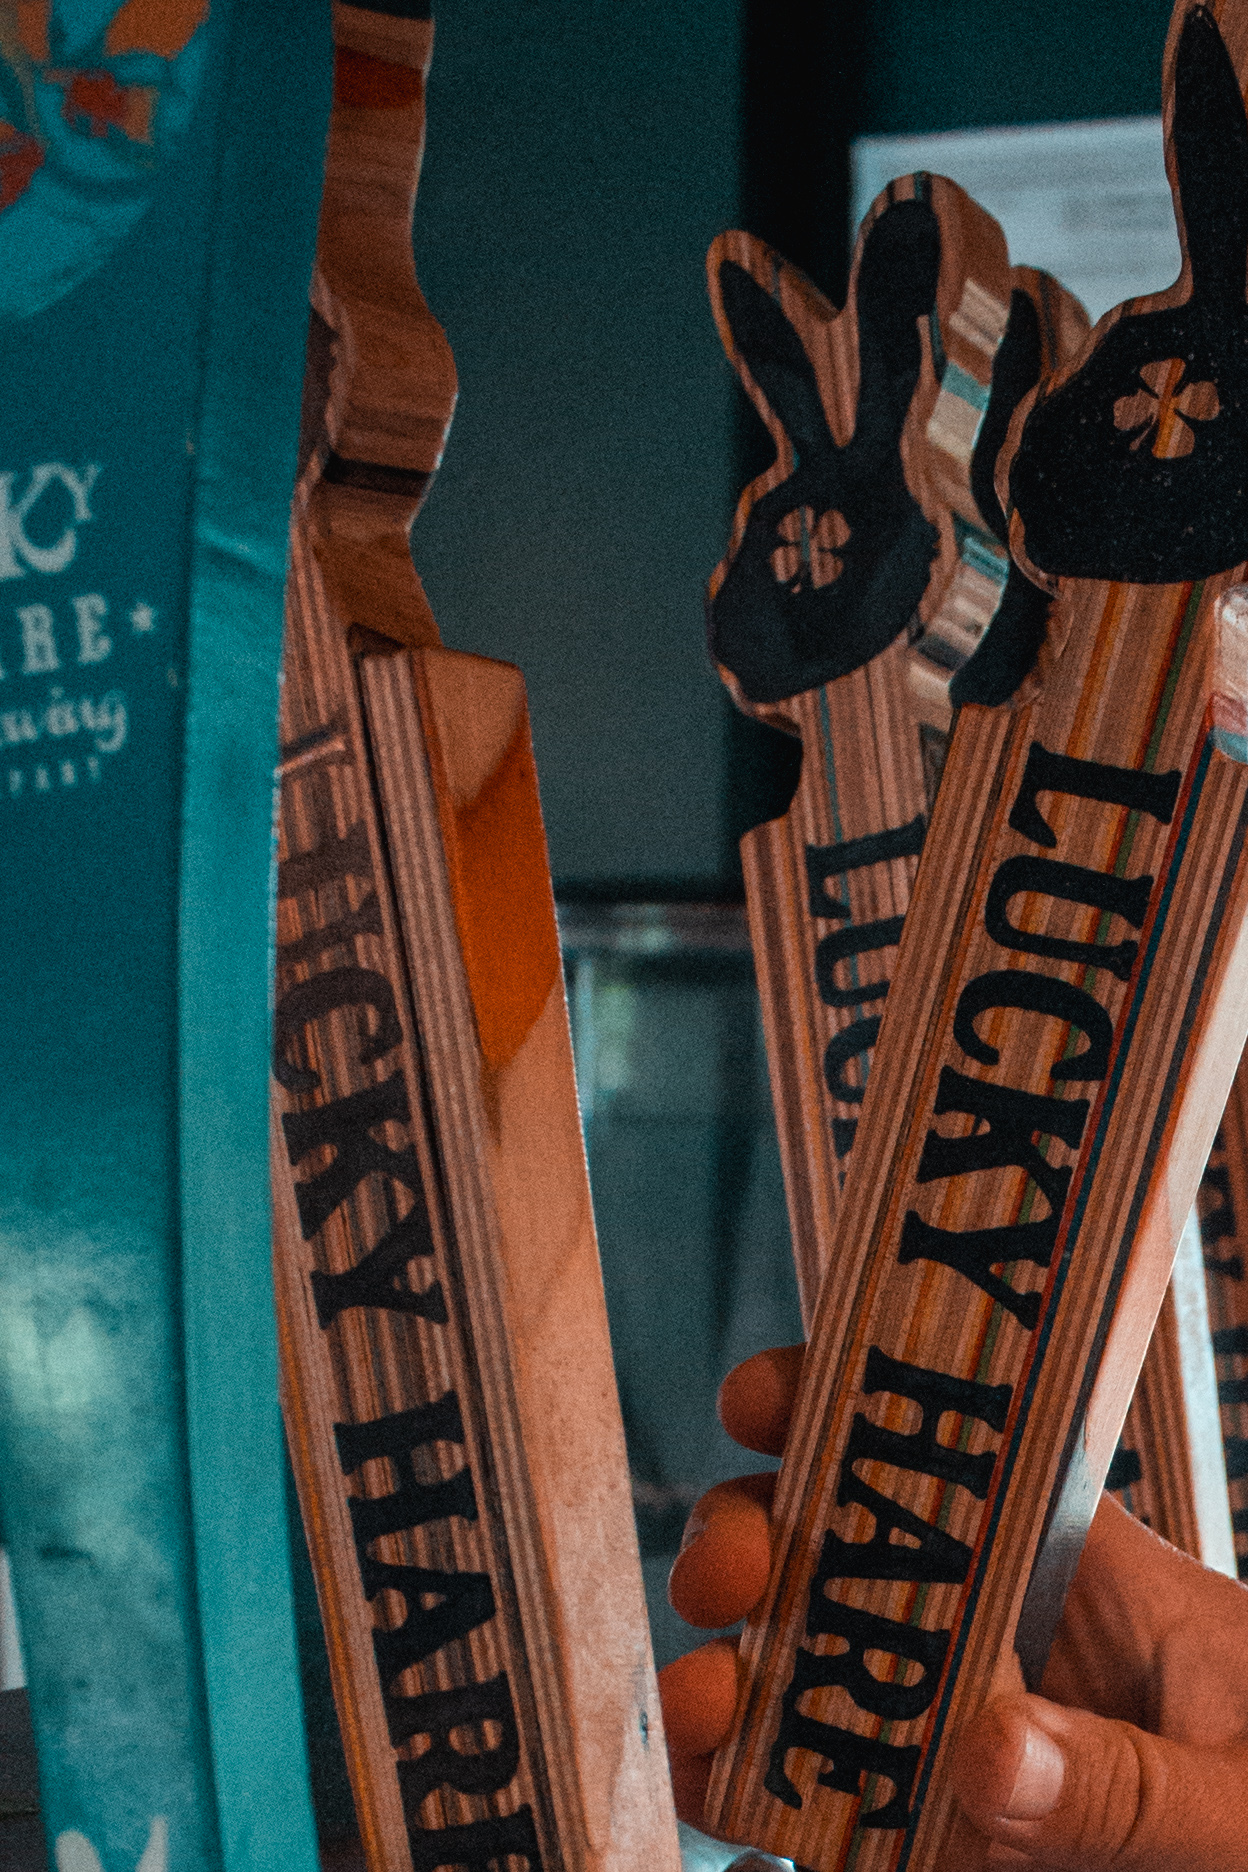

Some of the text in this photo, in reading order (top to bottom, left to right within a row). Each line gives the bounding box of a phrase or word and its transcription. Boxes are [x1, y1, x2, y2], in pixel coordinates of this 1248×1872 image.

[0, 593, 113, 678] RE
[804, 812, 929, 1192] LUC
[763, 739, 1184, 1833] LUCKY HARE
